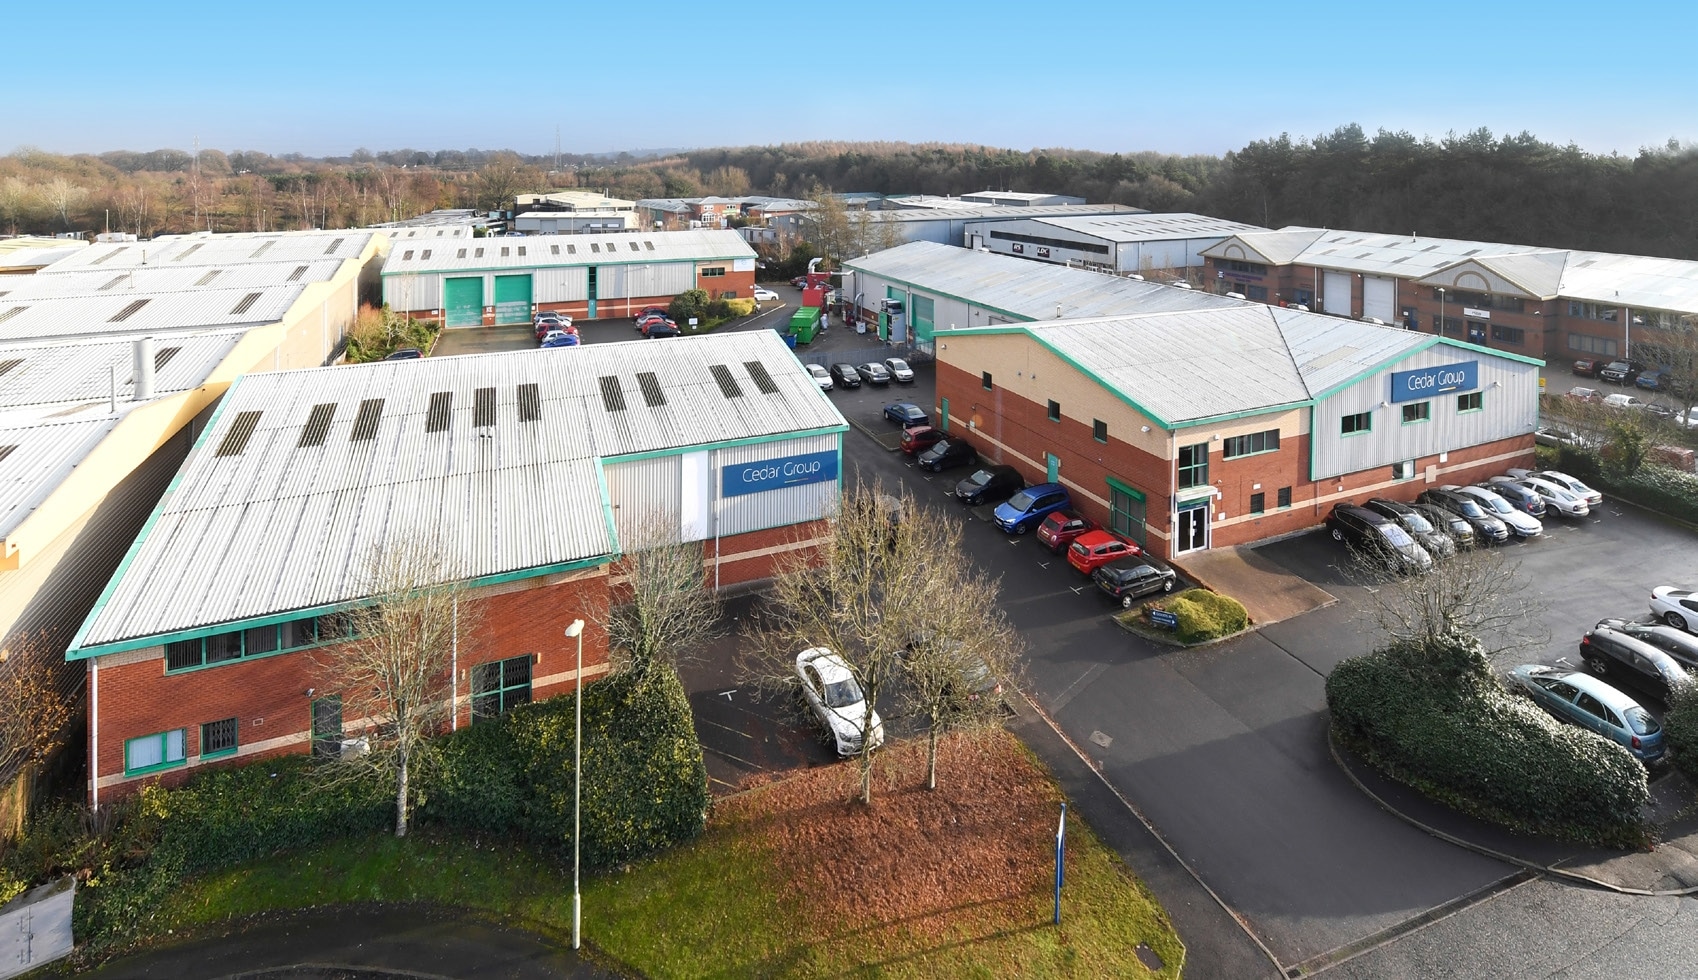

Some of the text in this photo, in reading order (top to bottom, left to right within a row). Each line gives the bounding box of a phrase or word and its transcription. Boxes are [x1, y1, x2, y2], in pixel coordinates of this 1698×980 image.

[1407, 370, 1465, 390] Cedar Group
[742, 460, 821, 483] Cedar Group
